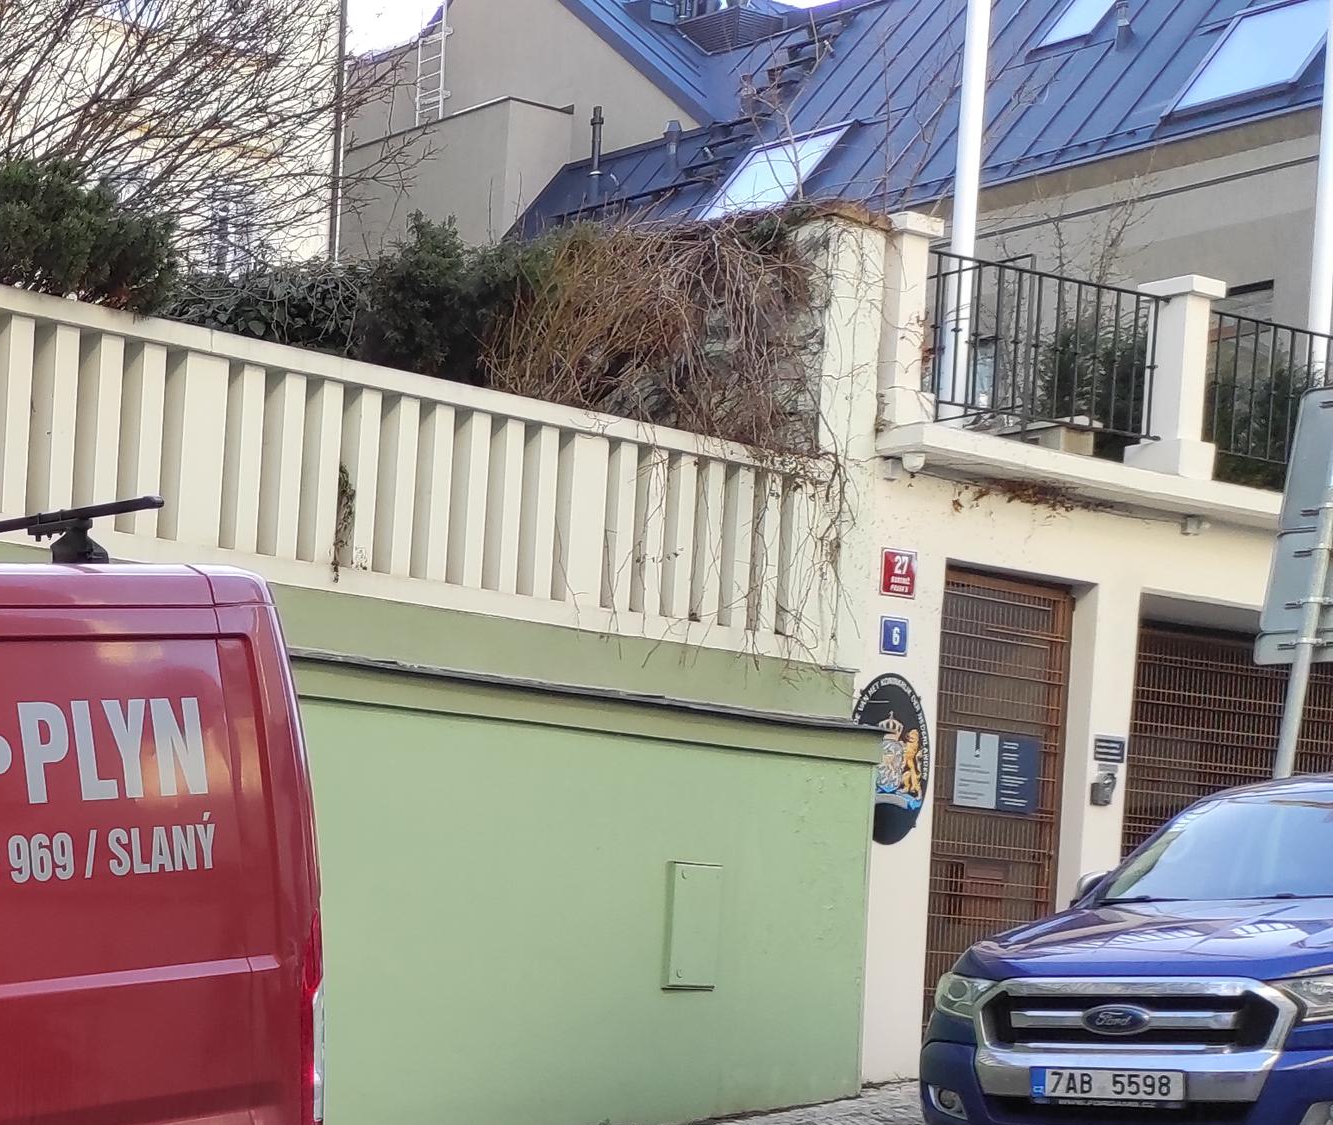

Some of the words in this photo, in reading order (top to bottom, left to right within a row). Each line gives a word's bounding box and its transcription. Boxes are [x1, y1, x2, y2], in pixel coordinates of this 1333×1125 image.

[893, 555, 909, 574] 27
[892, 626, 901, 646] 6
[18, 697, 211, 804] PLYN
[8, 832, 75, 884] 969
[108, 812, 216, 876] SLANÝ
[1095, 1011, 1133, 1026] Ford
[1050, 1071, 1093, 1094] 7AB
[1112, 1073, 1172, 1096] 5598
